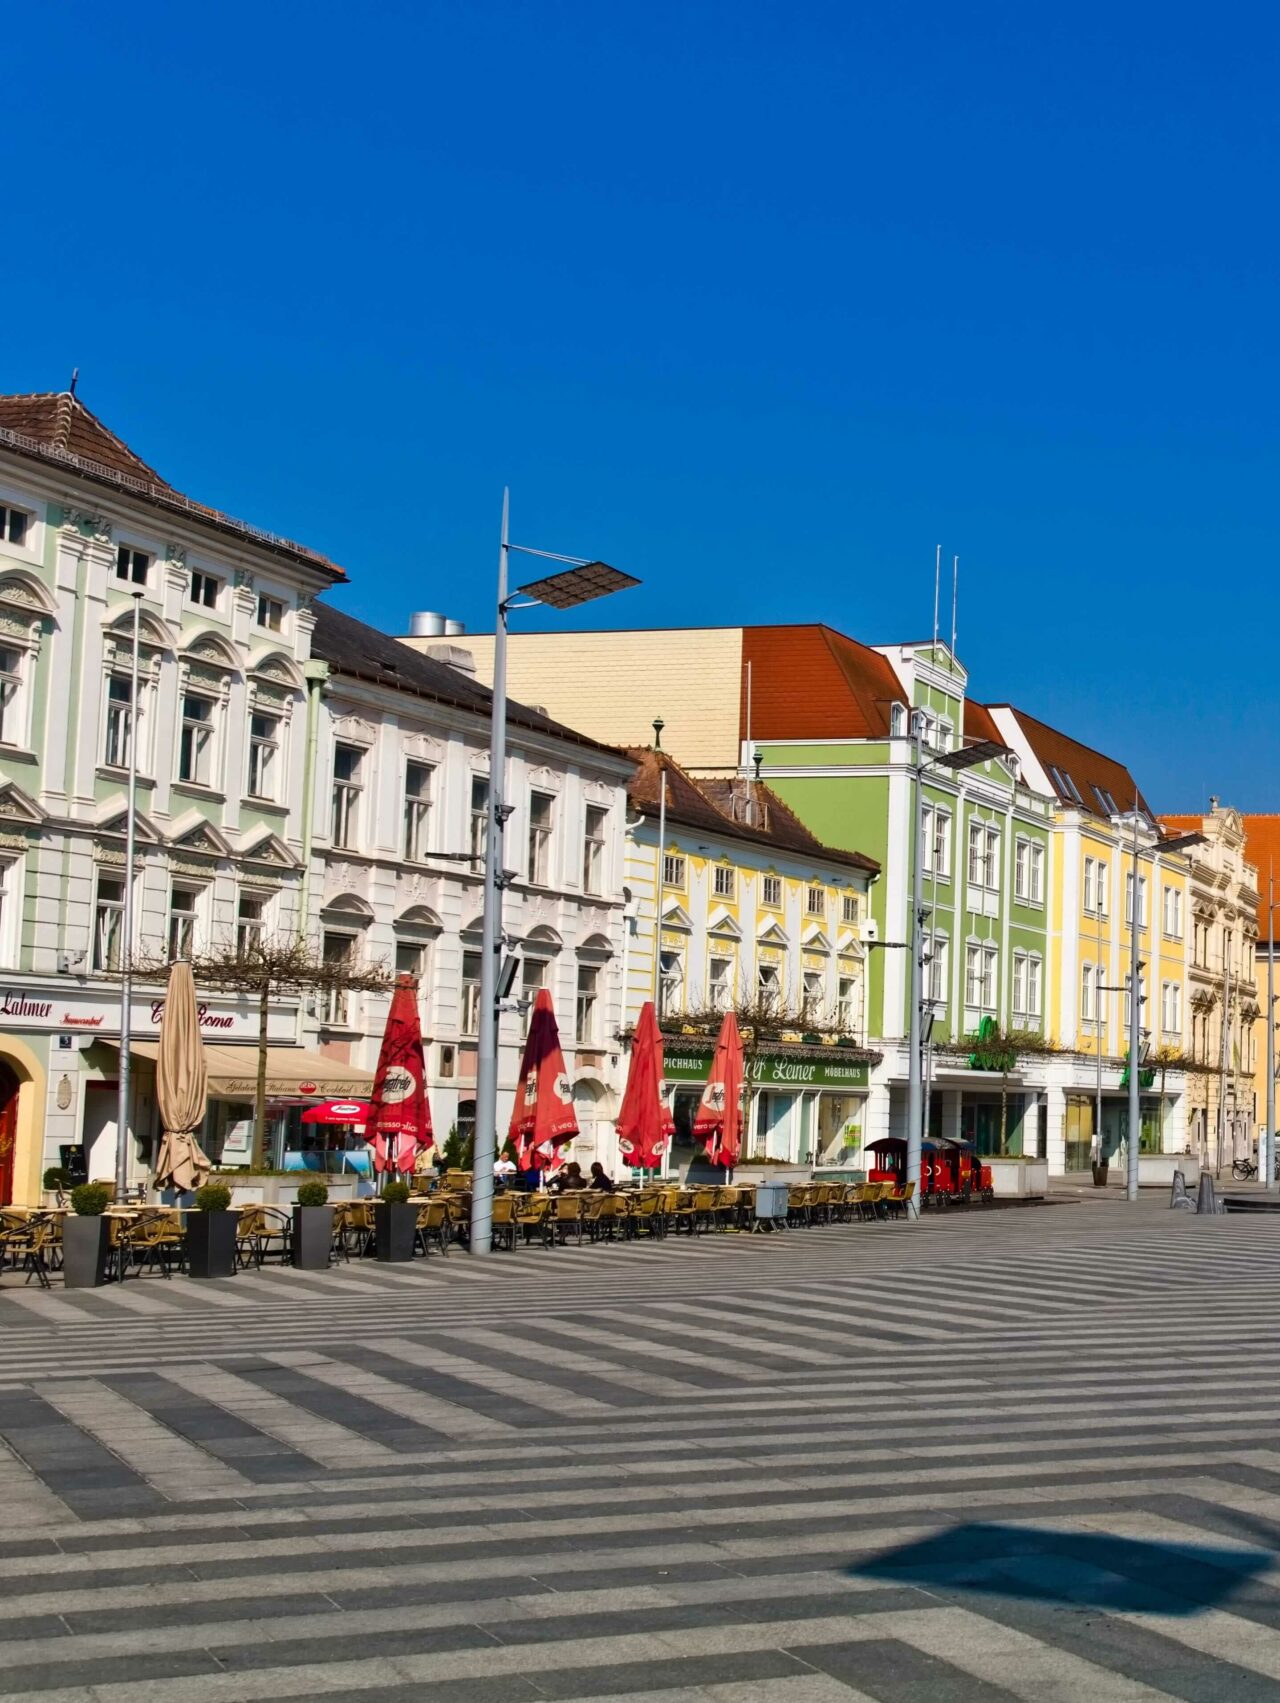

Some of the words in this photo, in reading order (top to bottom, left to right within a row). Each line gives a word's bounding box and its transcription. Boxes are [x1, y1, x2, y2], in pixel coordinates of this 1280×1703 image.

[0, 991, 52, 1017] Lahmer
[664, 1057, 703, 1070] PICHHAUS
[772, 1057, 816, 1081] Leiner
[824, 1068, 861, 1079] MÖBELHAUS
